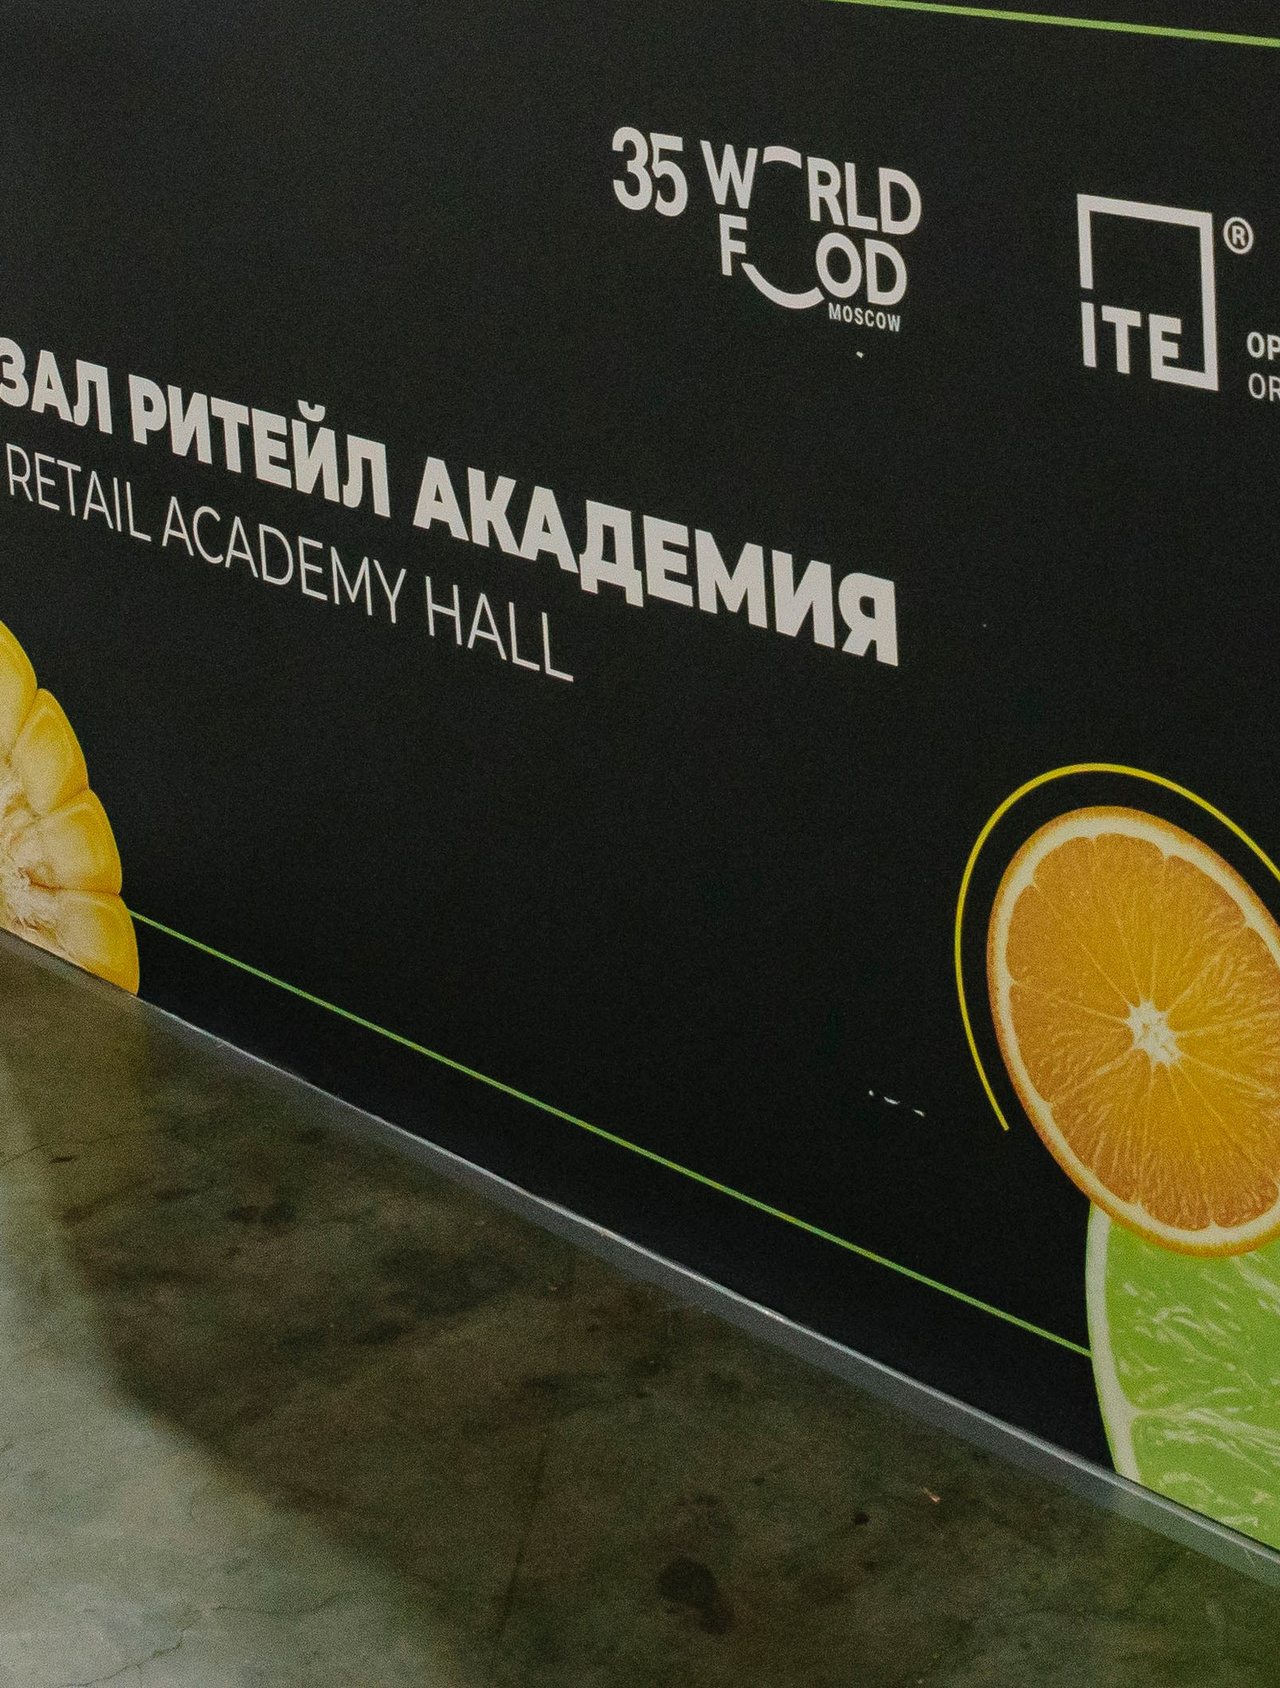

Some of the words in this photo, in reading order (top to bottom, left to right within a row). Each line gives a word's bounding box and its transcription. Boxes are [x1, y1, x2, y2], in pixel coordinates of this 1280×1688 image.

[611, 126, 688, 218] 35
[827, 301, 903, 334] MOSCOW
[0, 335, 114, 436] ЗАЛ
[127, 373, 392, 519] РИТЕЙЛ
[412, 455, 900, 669] АКАДЕМИЯ
[6, 442, 152, 544] RETAIL
[162, 496, 407, 627] ACADEMY
[425, 575, 575, 684] HALL
